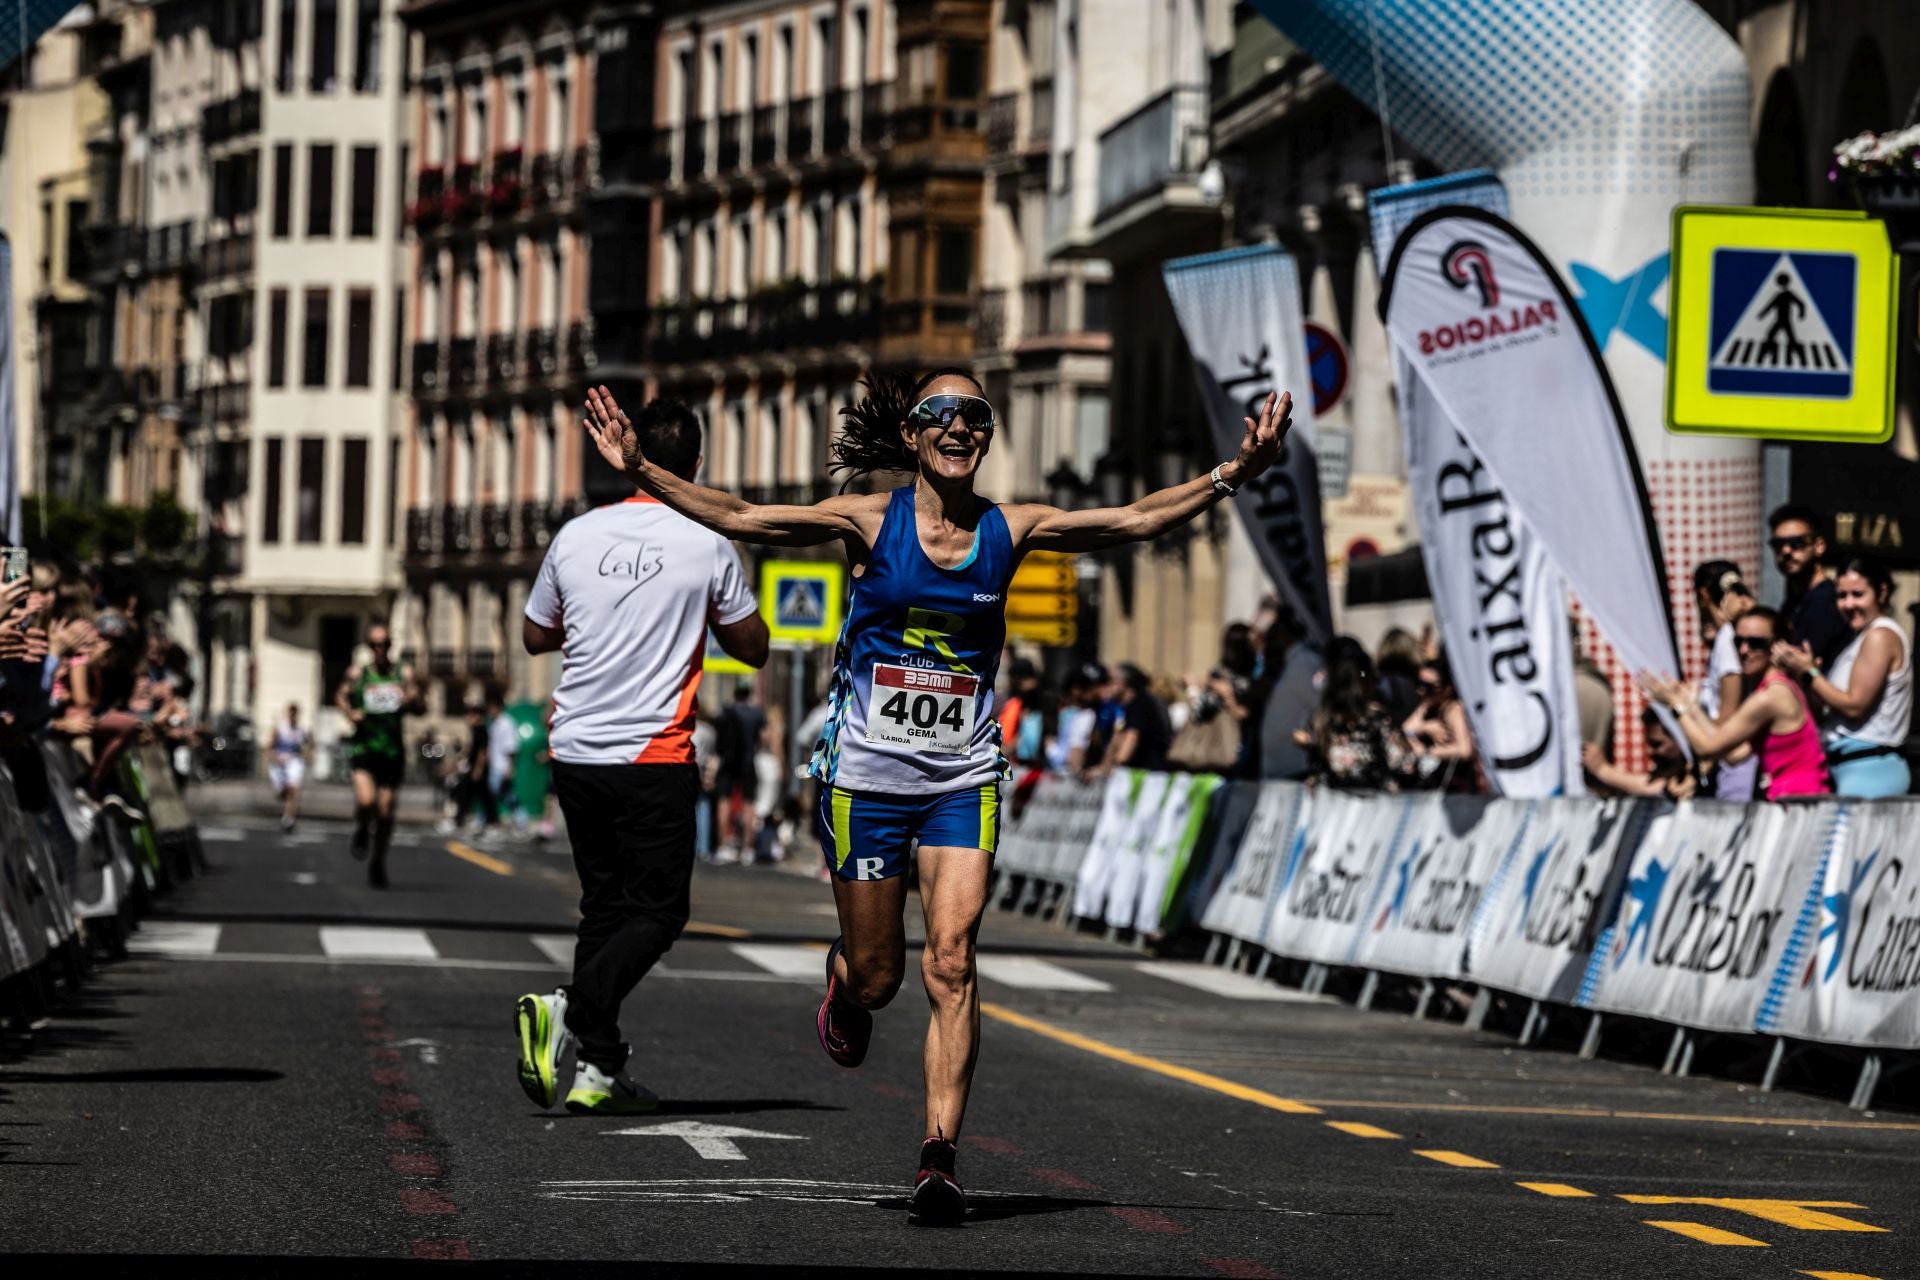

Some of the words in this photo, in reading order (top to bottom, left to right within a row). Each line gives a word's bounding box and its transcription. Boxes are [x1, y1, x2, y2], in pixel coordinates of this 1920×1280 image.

[1436, 428, 1551, 771] CaixaB
[899, 653, 935, 668] CLUB
[879, 691, 964, 732] 404
[891, 736, 911, 744] RIOJA
[906, 728, 937, 739] GEMA
[856, 856, 885, 881] R
